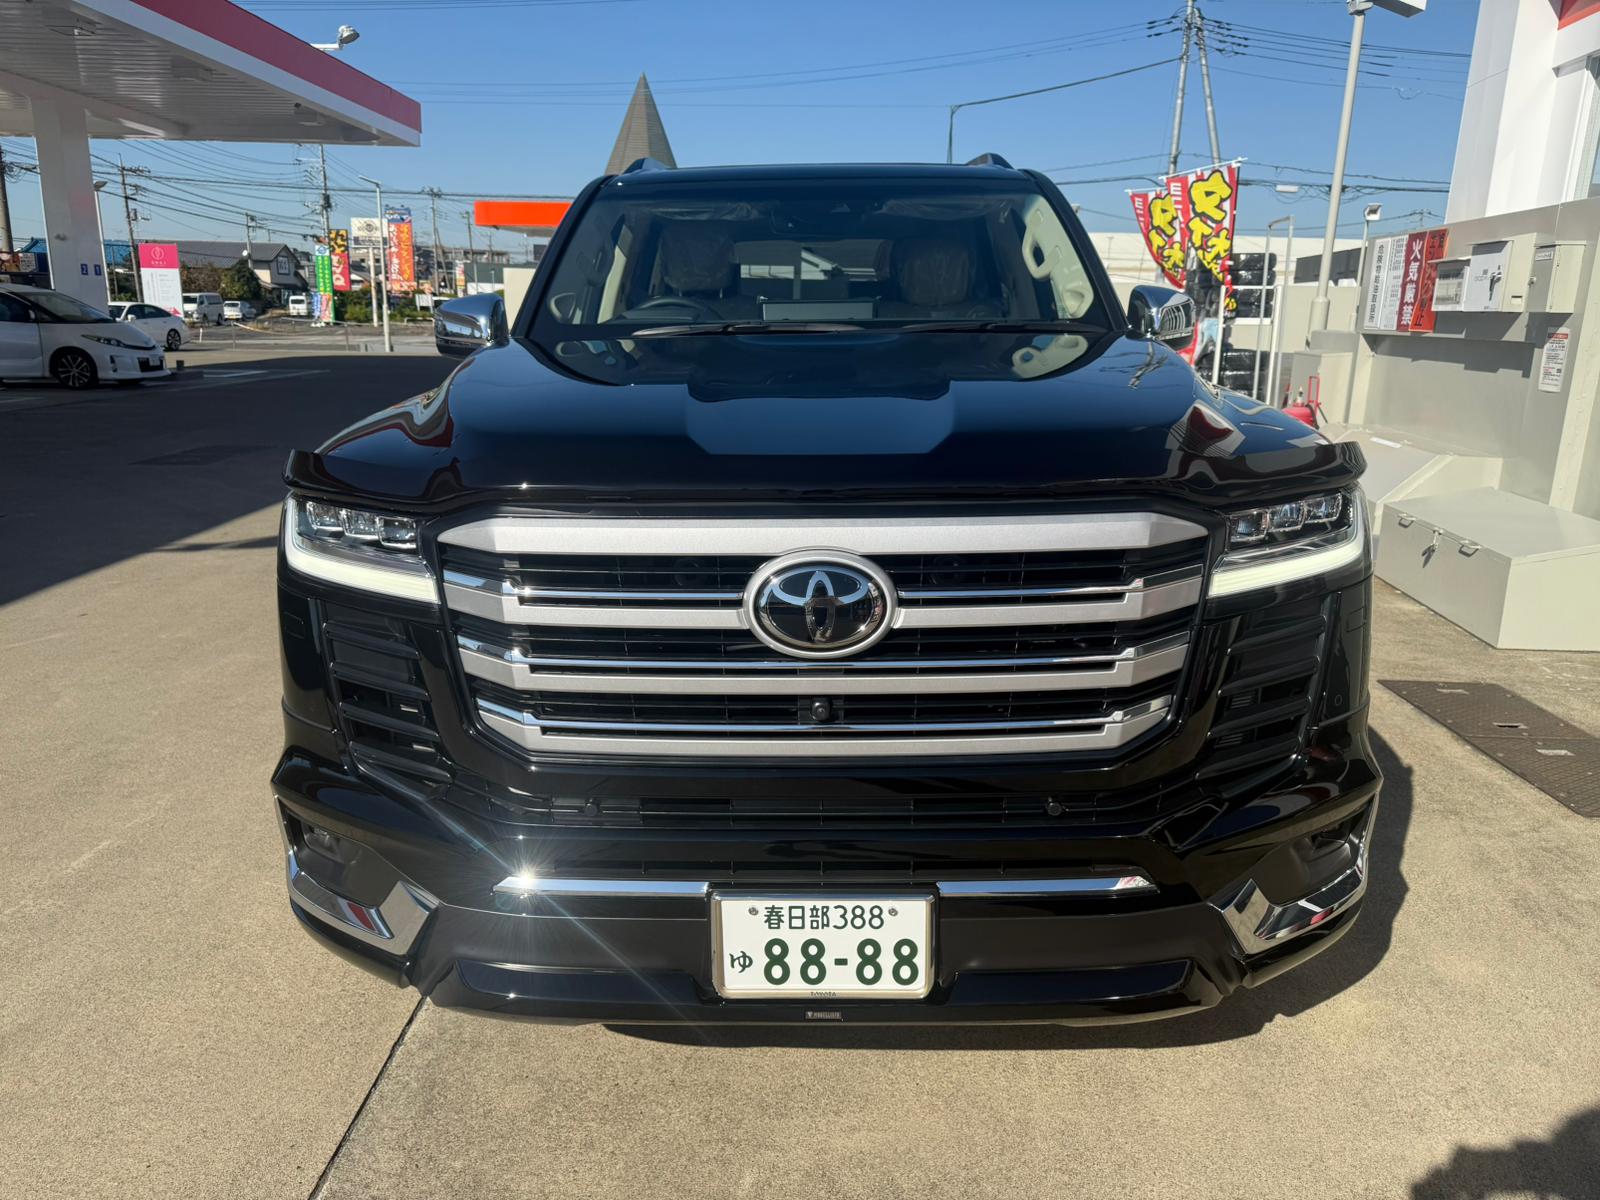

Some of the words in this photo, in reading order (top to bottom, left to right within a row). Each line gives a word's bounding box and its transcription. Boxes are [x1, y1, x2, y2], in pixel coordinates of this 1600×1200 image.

[763, 904, 885, 930] 春日部388
[729, 950, 754, 973] ゆ
[763, 938, 919, 986] 88-88
